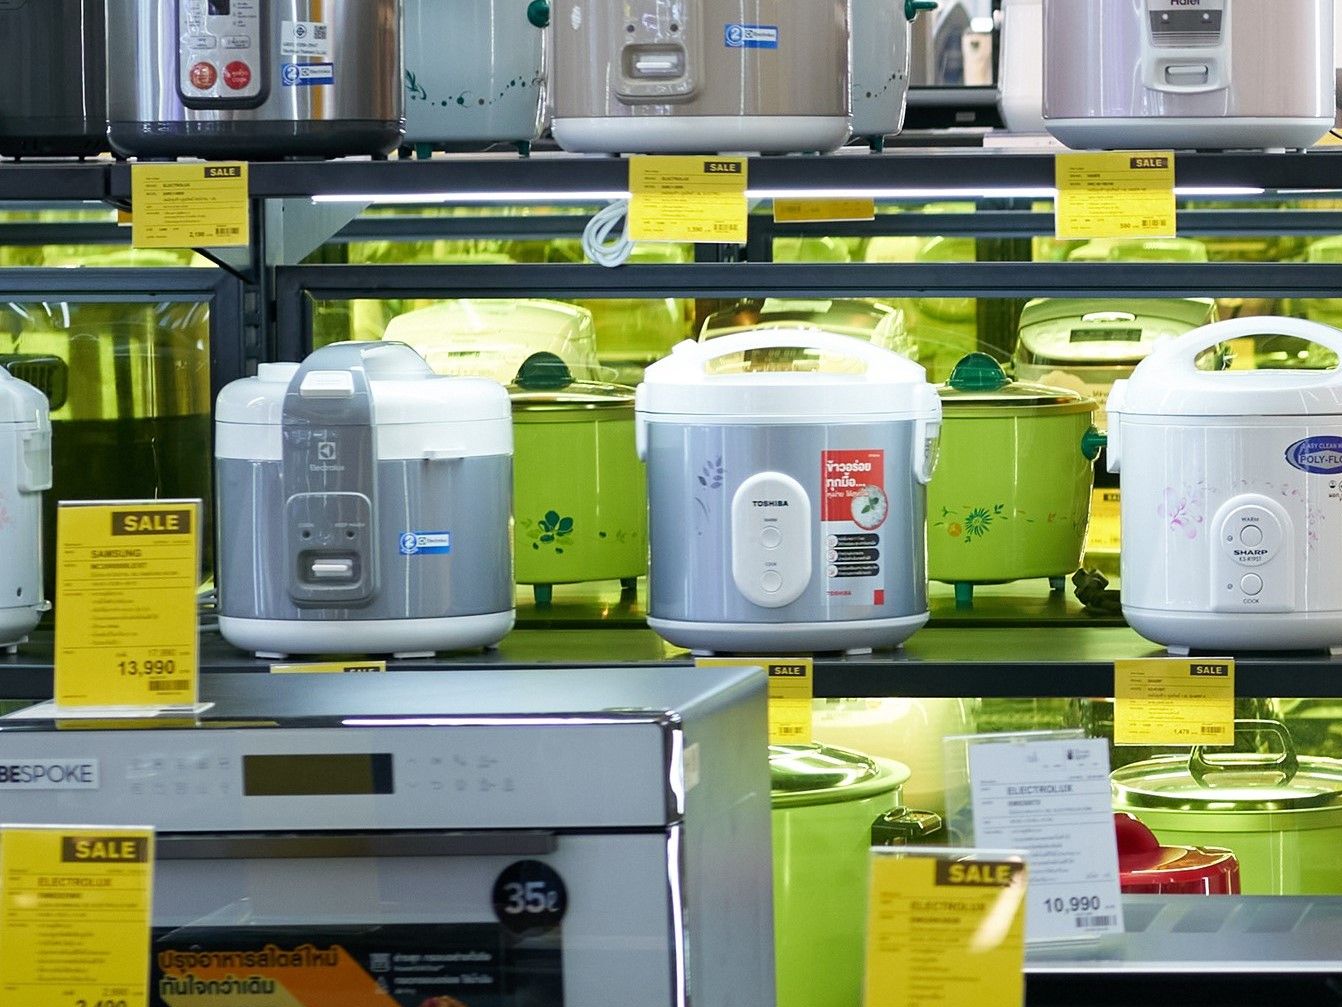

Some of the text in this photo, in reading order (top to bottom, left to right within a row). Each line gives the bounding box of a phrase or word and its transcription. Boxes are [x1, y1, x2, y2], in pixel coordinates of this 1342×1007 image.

[709, 163, 736, 172] SALE
[1136, 159, 1162, 168] SALE
[210, 168, 236, 177] SALE
[124, 514, 180, 531] SALE
[91, 549, 142, 559] SAMSUNG
[117, 659, 175, 677] 13,990
[774, 667, 800, 675] SALE
[1196, 666, 1222, 674] SALE
[0, 764, 93, 783] BESPOKE
[1007, 784, 1073, 796] ELECTROLUX
[74, 840, 136, 859] SALE
[948, 862, 1011, 884] SALE
[1045, 896, 1101, 916] 10,990
